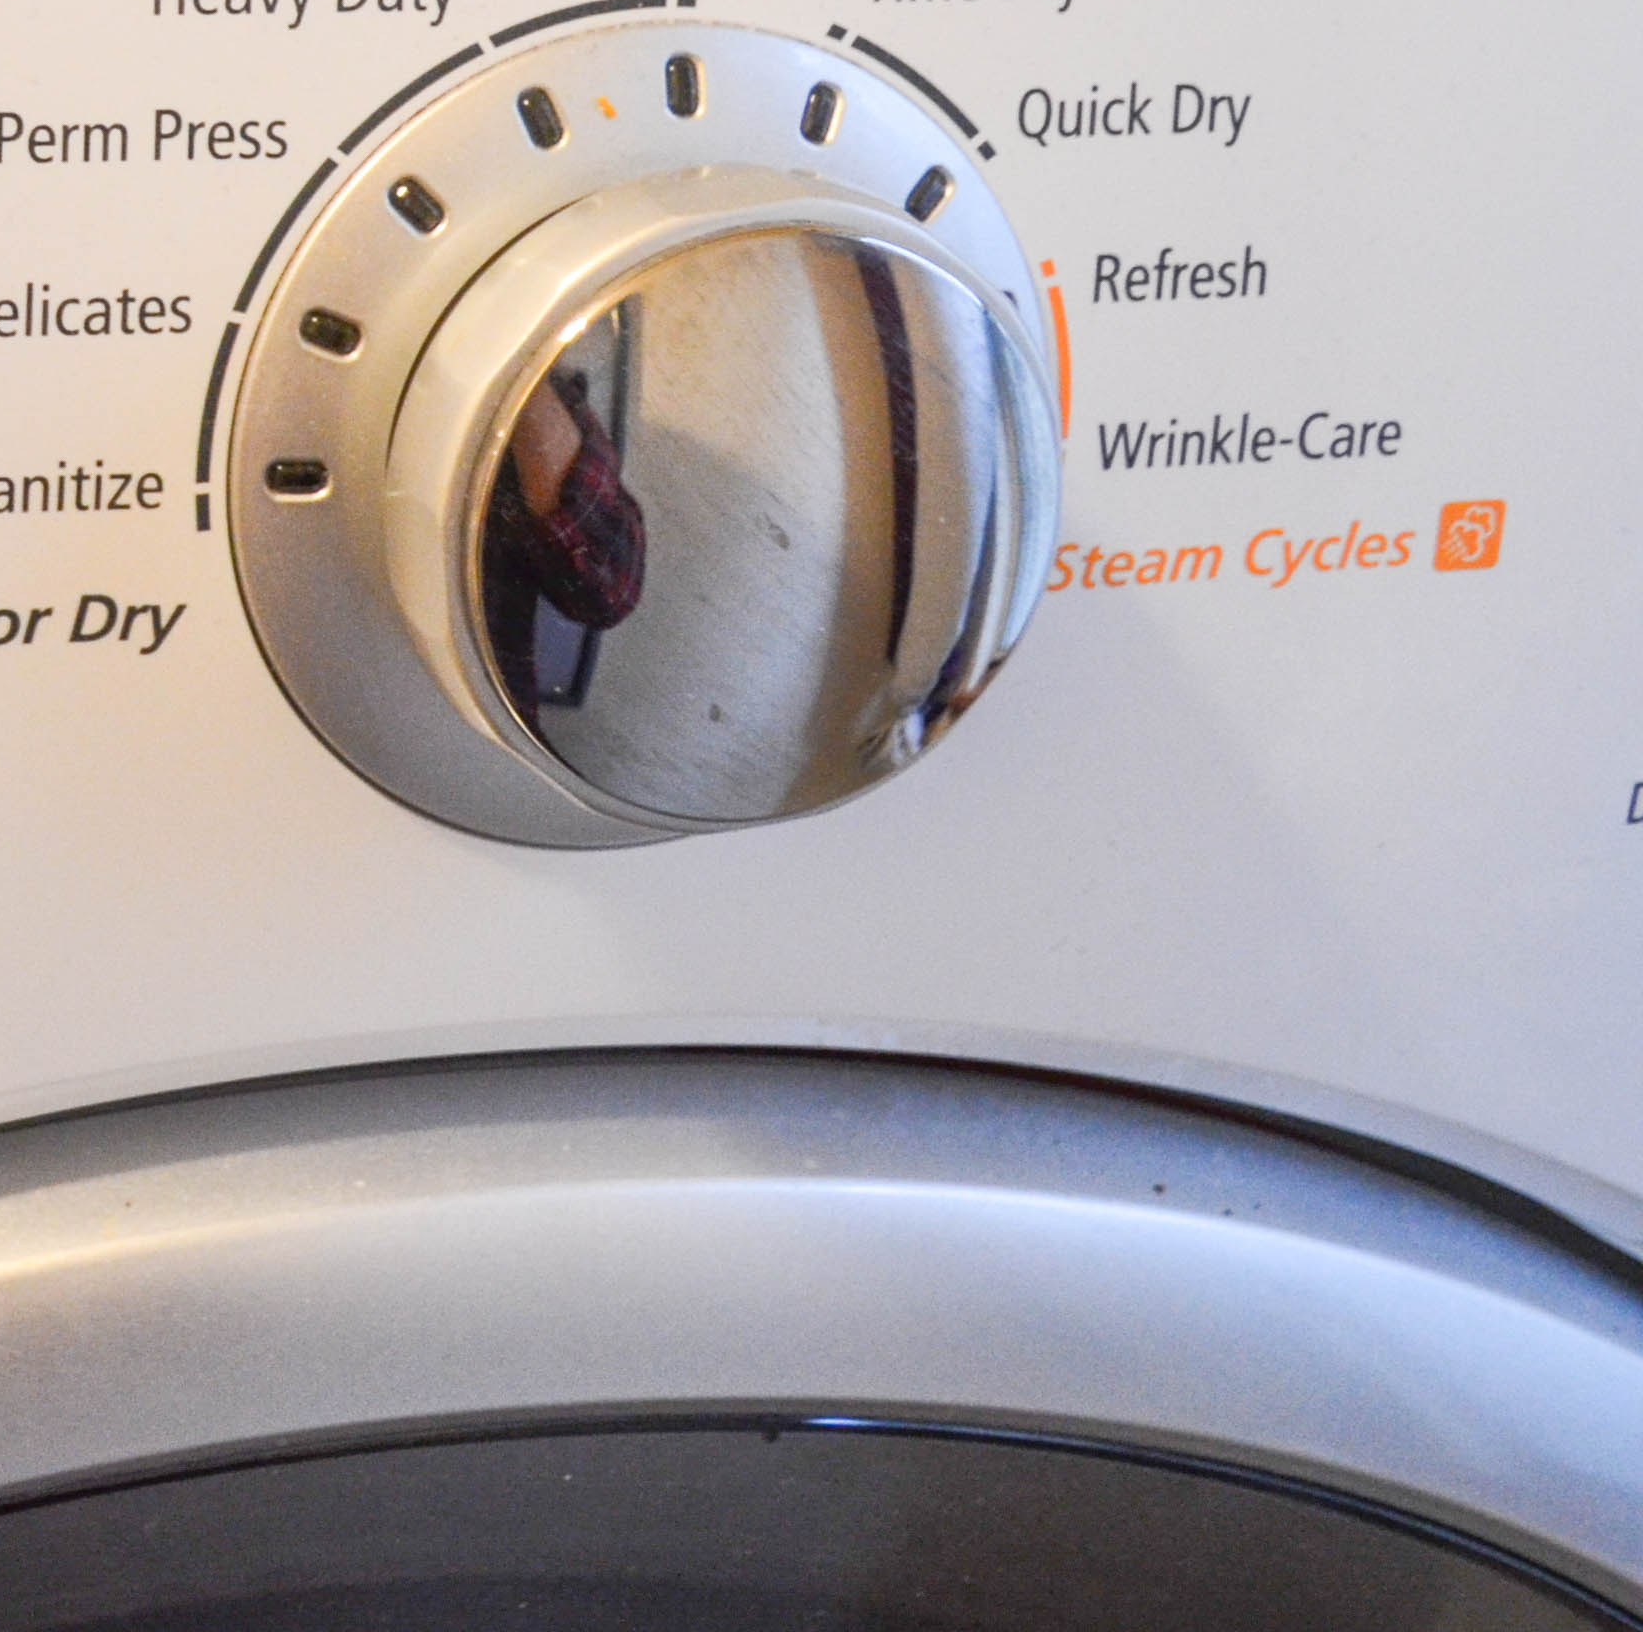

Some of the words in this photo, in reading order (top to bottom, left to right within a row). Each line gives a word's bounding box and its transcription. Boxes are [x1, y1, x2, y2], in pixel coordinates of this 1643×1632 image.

[154, 109, 288, 161] Press
[1018, 81, 1152, 148] Quick
[1172, 83, 1252, 148] Dry
[1093, 245, 1267, 303] Refresh
[1098, 411, 1402, 471] Wrinkle-Care
[1046, 543, 1223, 591] Steam
[1244, 520, 1416, 589] Cycles
[68, 594, 187, 656] Dry
